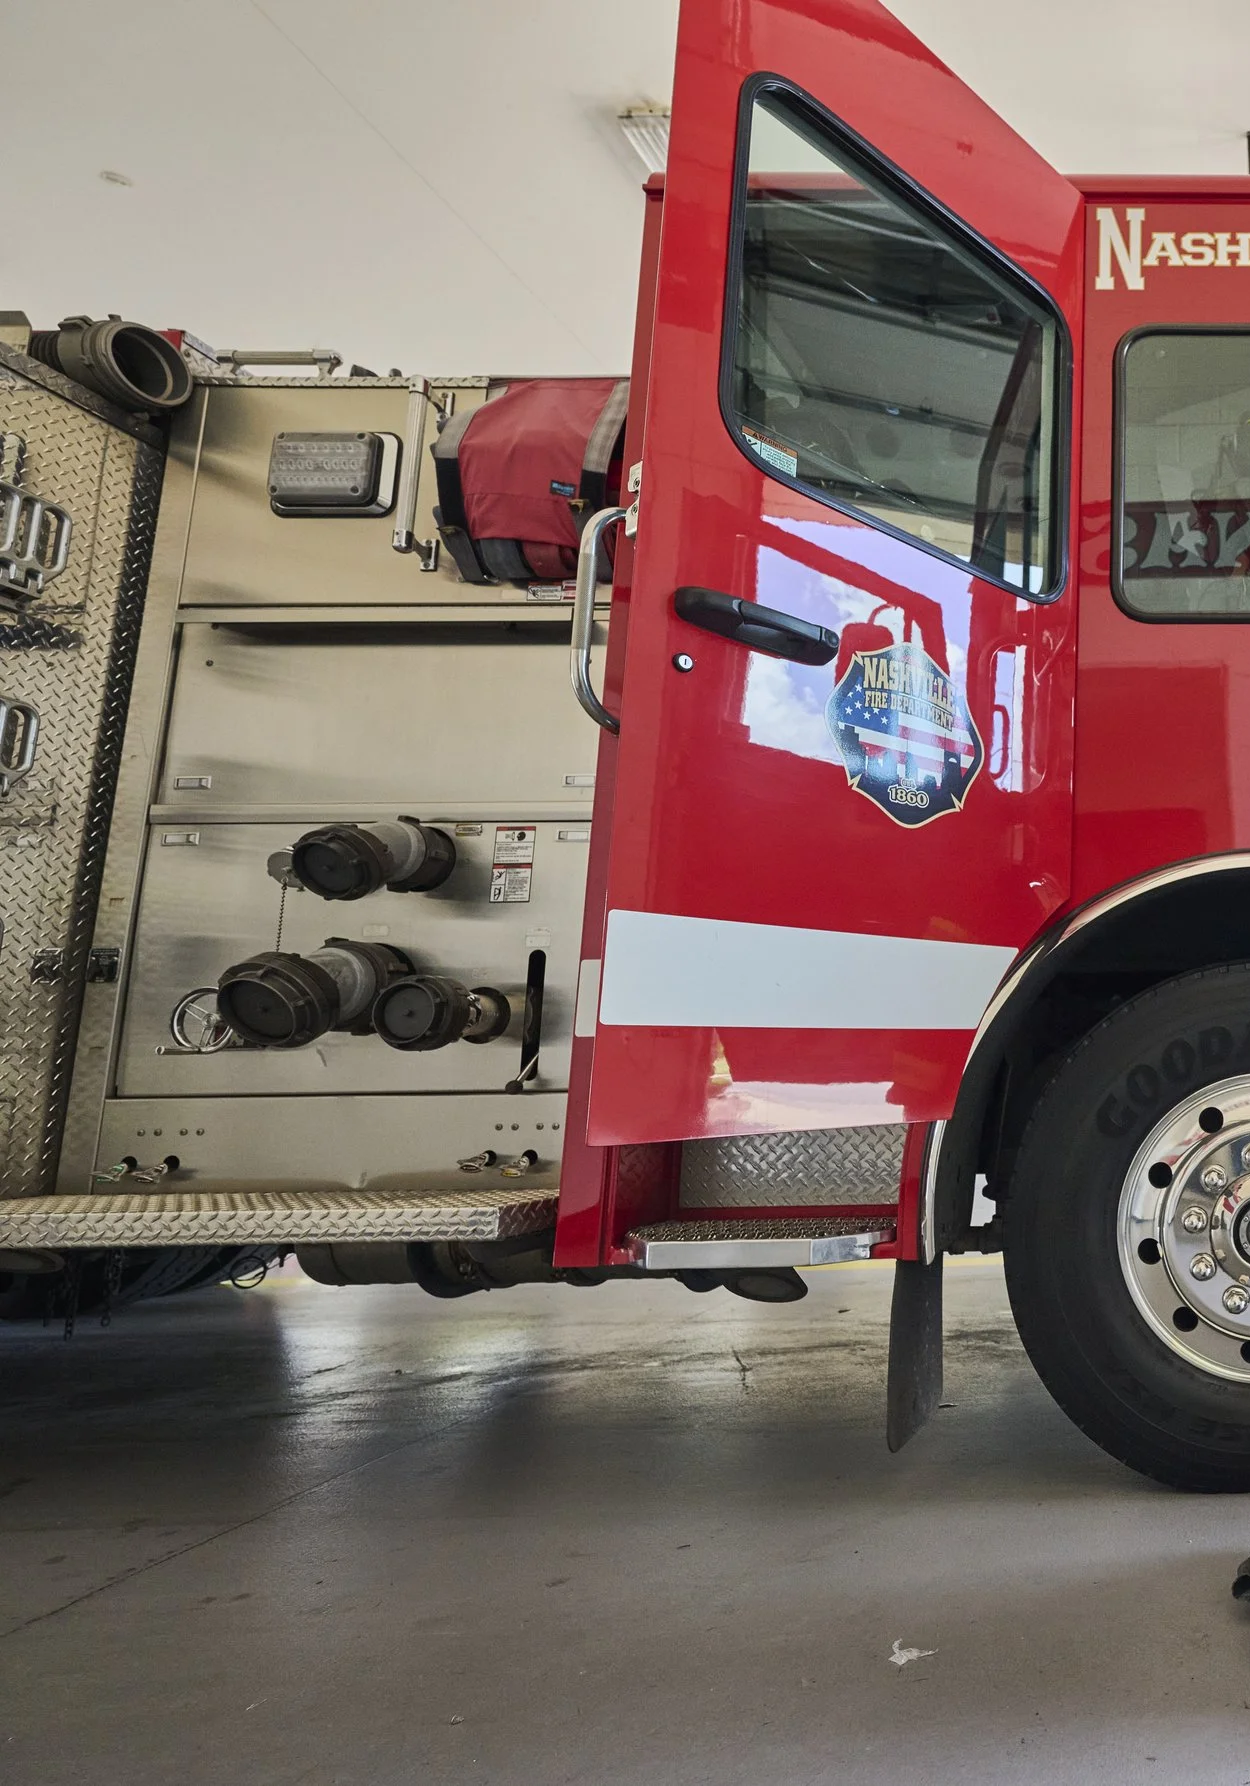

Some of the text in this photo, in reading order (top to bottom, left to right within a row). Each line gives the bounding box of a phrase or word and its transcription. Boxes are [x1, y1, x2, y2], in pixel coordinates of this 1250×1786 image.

[863, 656, 955, 713] NASHVILLE
[864, 690, 953, 732] FIRE DEPARTMENT
[889, 786, 929, 807] 1860
